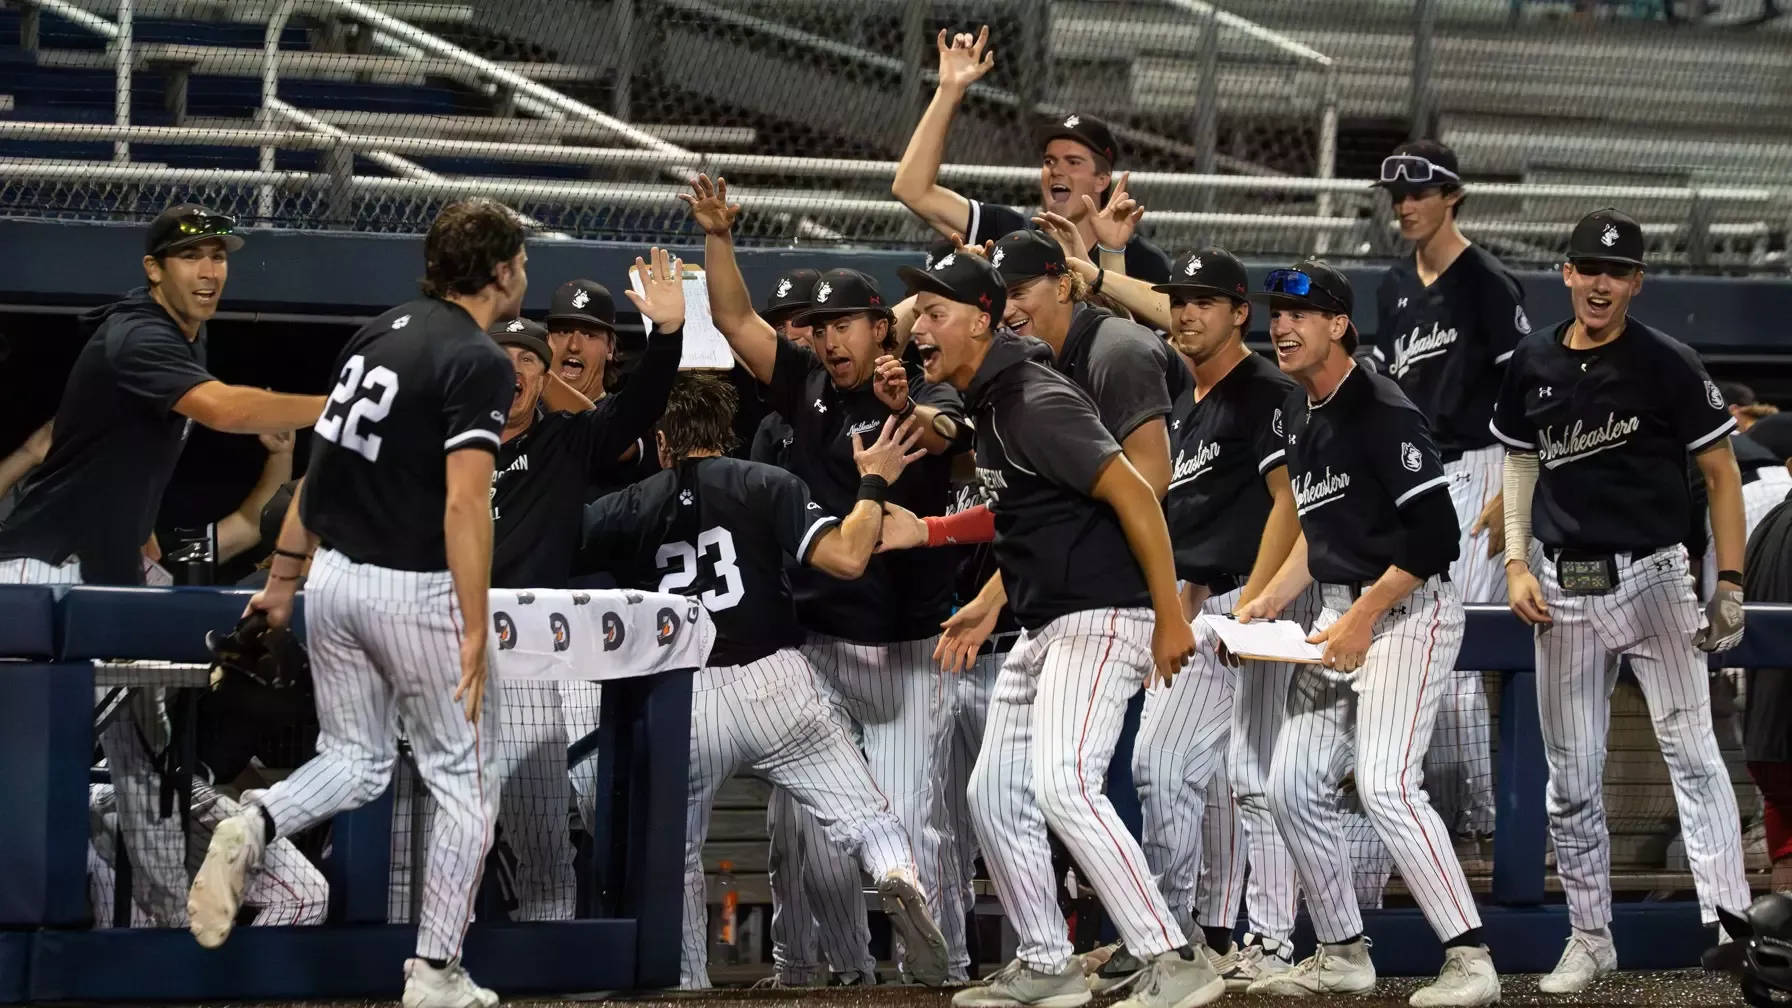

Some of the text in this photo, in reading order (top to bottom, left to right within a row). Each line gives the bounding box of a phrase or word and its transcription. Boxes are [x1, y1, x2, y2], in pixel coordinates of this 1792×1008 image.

[314, 354, 399, 463] 22
[1539, 412, 1639, 460] Northeastern
[655, 525, 745, 613] 23
